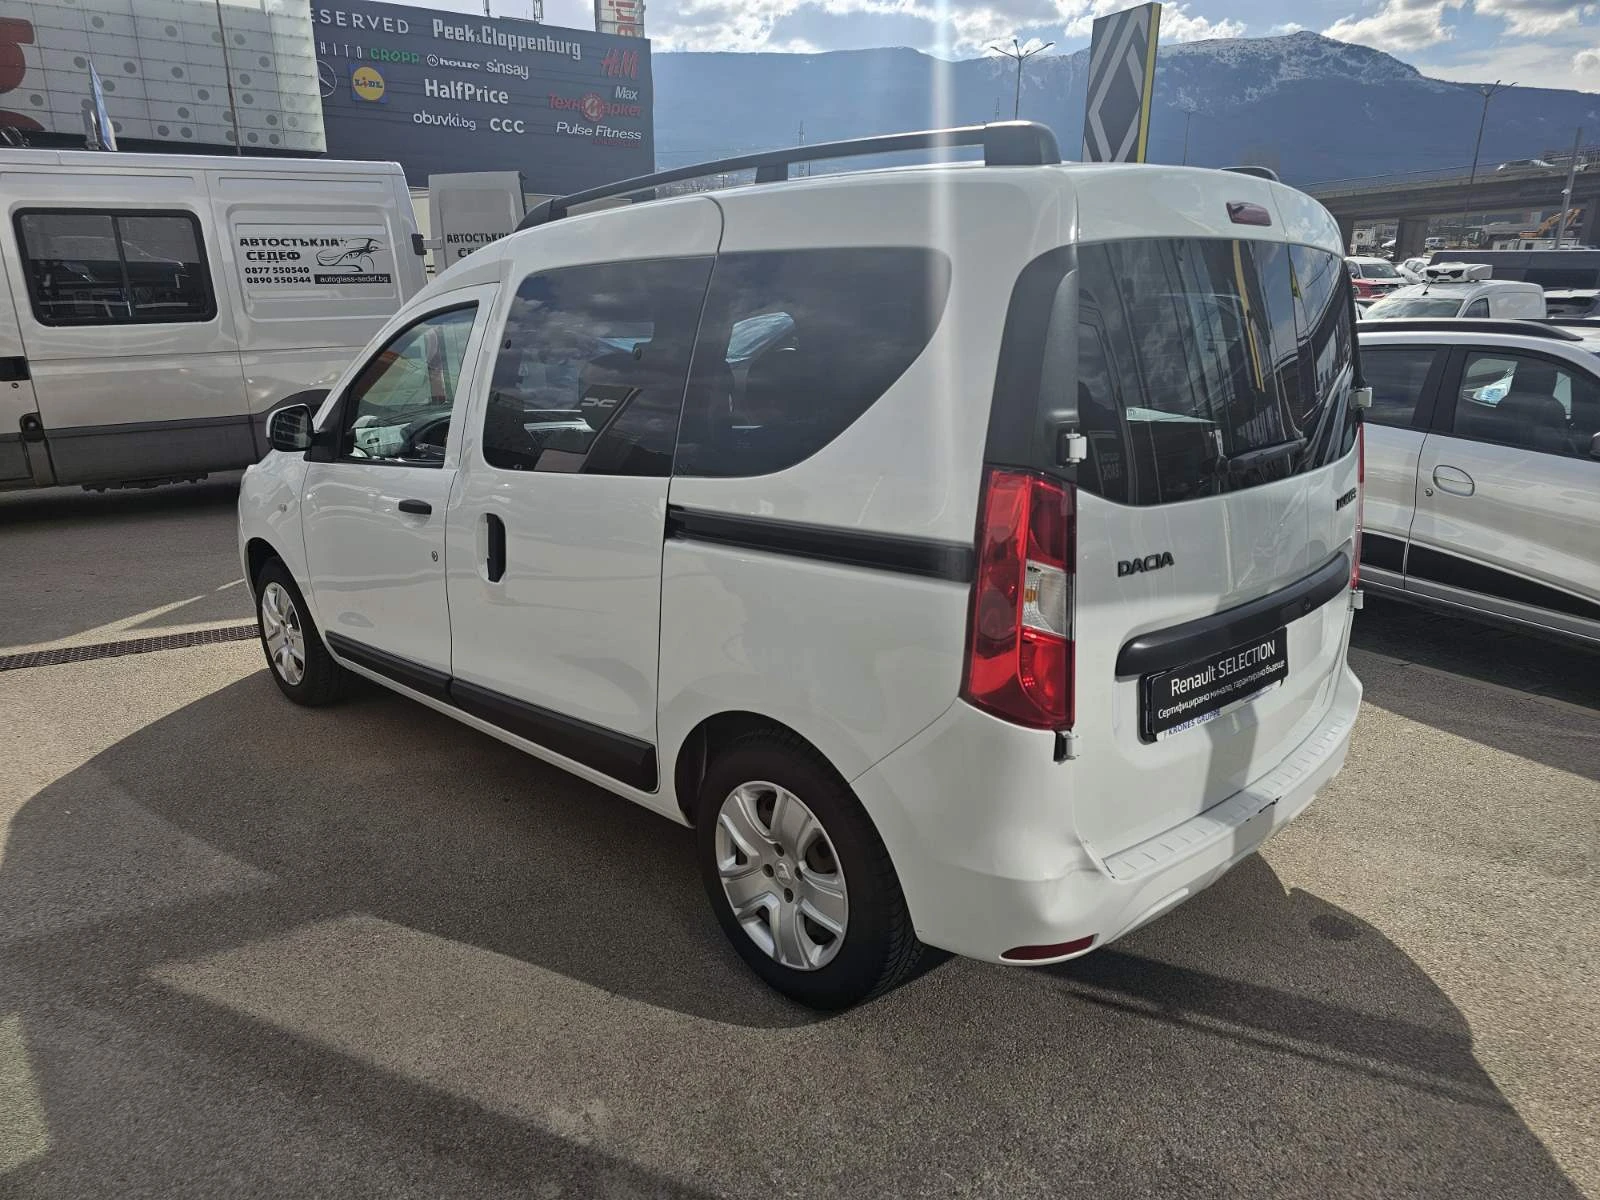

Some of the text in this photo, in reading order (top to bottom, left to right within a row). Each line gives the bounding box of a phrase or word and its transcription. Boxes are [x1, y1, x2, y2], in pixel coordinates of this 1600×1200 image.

[370, 47, 420, 63] CROPP
[601, 47, 639, 80] H&M
[486, 58, 529, 80] sinsay
[424, 78, 509, 104] HalfPrice
[413, 110, 476, 131] obuvki.bg
[489, 118, 525, 133] CCC
[556, 121, 642, 140] Pulse Fitness
[239, 238, 340, 247] АВТОСТЪКЛА
[246, 250, 301, 263] СЕДЕФ
[244, 266, 270, 274] 0877
[246, 276, 311, 284] 0890 550544
[1117, 551, 1175, 577] DACIA
[1171, 639, 1275, 697] Renault SELECTION
[1157, 692, 1210, 719] Сертифицирано
